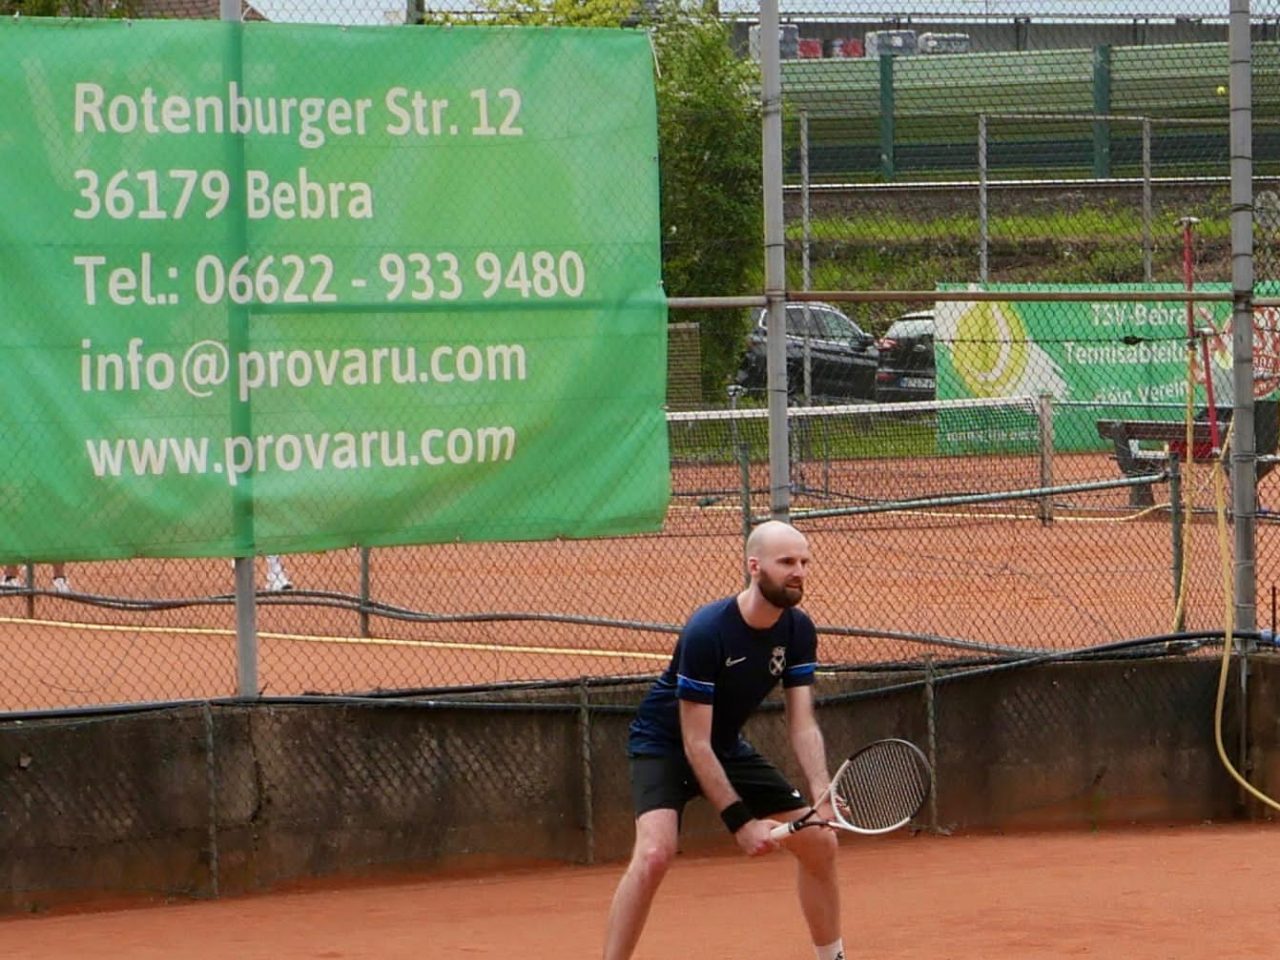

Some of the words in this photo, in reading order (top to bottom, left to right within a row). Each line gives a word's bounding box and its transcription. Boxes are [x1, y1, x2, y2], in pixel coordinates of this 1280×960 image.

[75, 83, 370, 148] Rotenburger
[385, 87, 458, 135] Str.
[471, 88, 523, 136] 12
[74, 169, 229, 219] 36179
[247, 169, 373, 219] Bebra
[75, 255, 178, 305] Tel.:
[195, 255, 337, 304] 06622
[379, 252, 462, 300] 933
[475, 251, 585, 298] 9480
[80, 340, 526, 400] info@provaru.com
[87, 426, 517, 485] www.provaru.com
